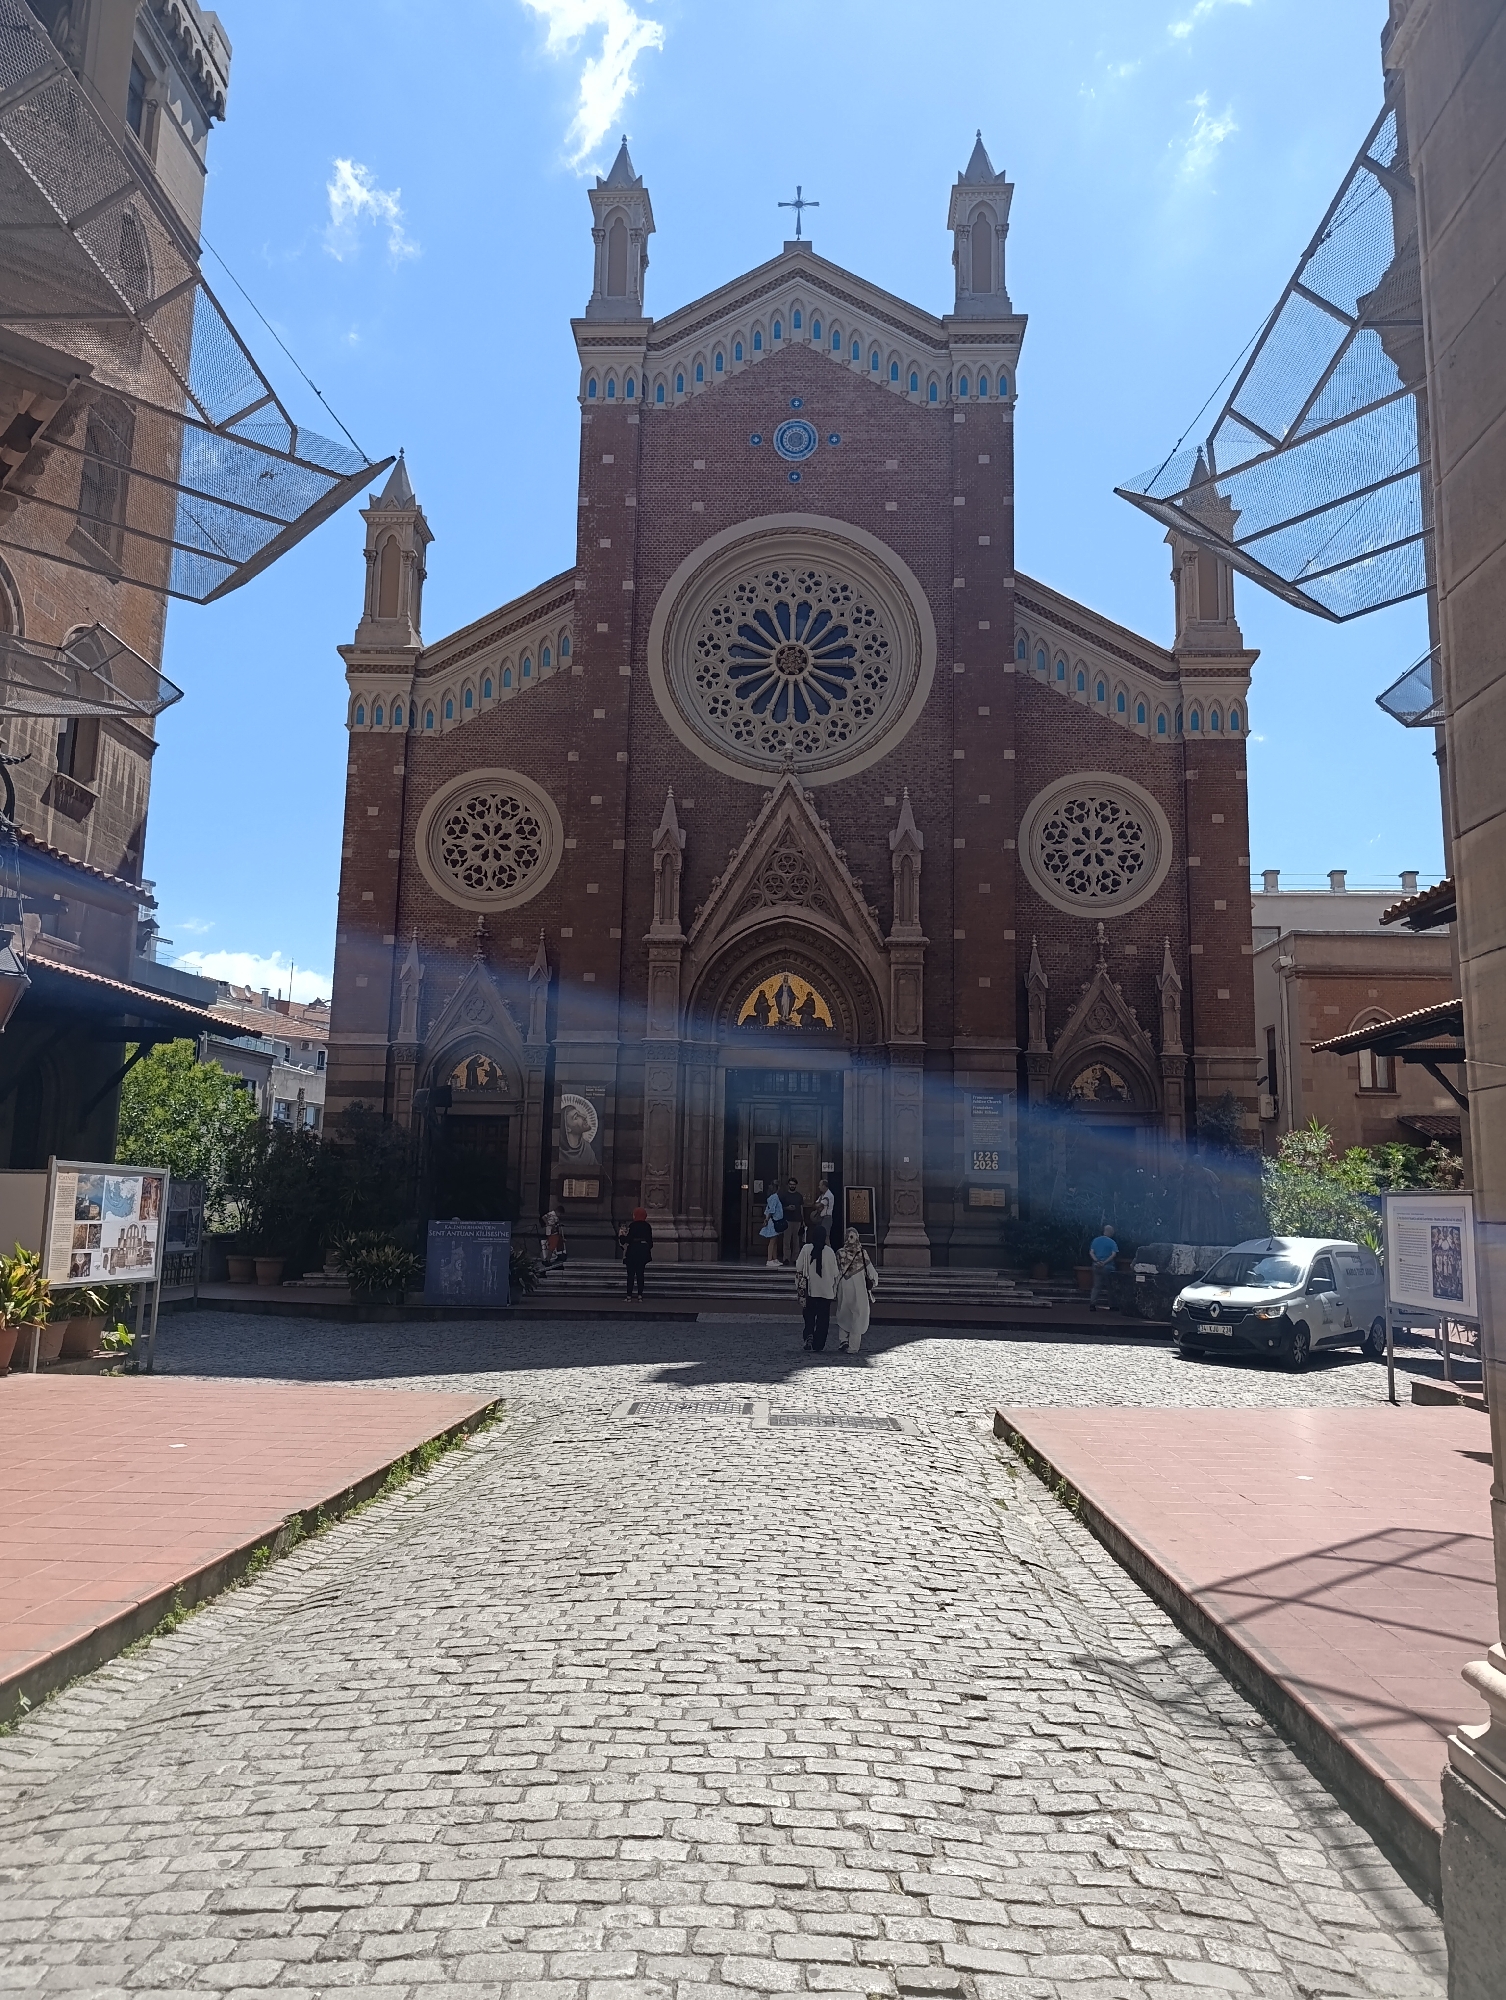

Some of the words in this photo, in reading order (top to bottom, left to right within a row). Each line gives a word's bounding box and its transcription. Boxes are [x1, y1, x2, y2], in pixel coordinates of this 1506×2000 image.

[973, 1151, 999, 1160] 1226
[973, 1160, 999, 1170] 2026
[428, 1229, 446, 1237] SENT
